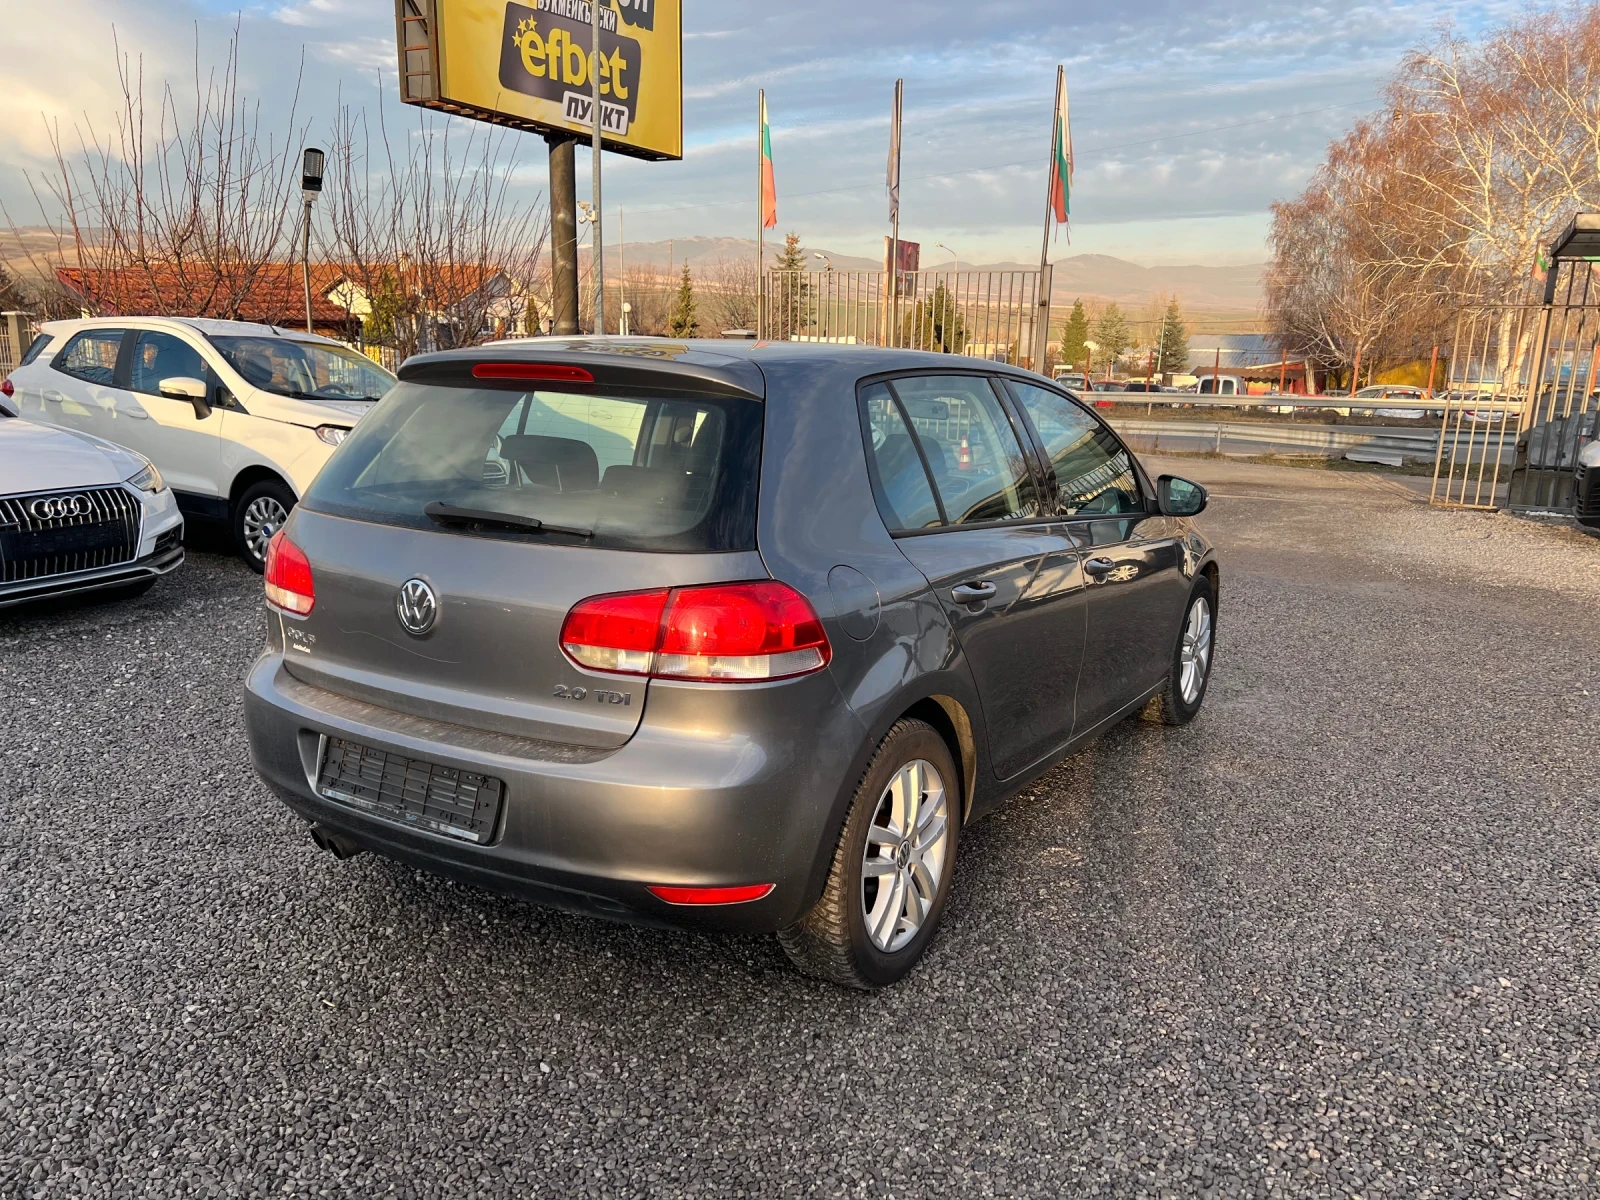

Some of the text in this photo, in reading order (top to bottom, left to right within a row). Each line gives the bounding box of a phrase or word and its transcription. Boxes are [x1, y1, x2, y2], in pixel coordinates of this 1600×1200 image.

[520, 28, 628, 100] efbet
[553, 684, 631, 706] 2.0 TDI
